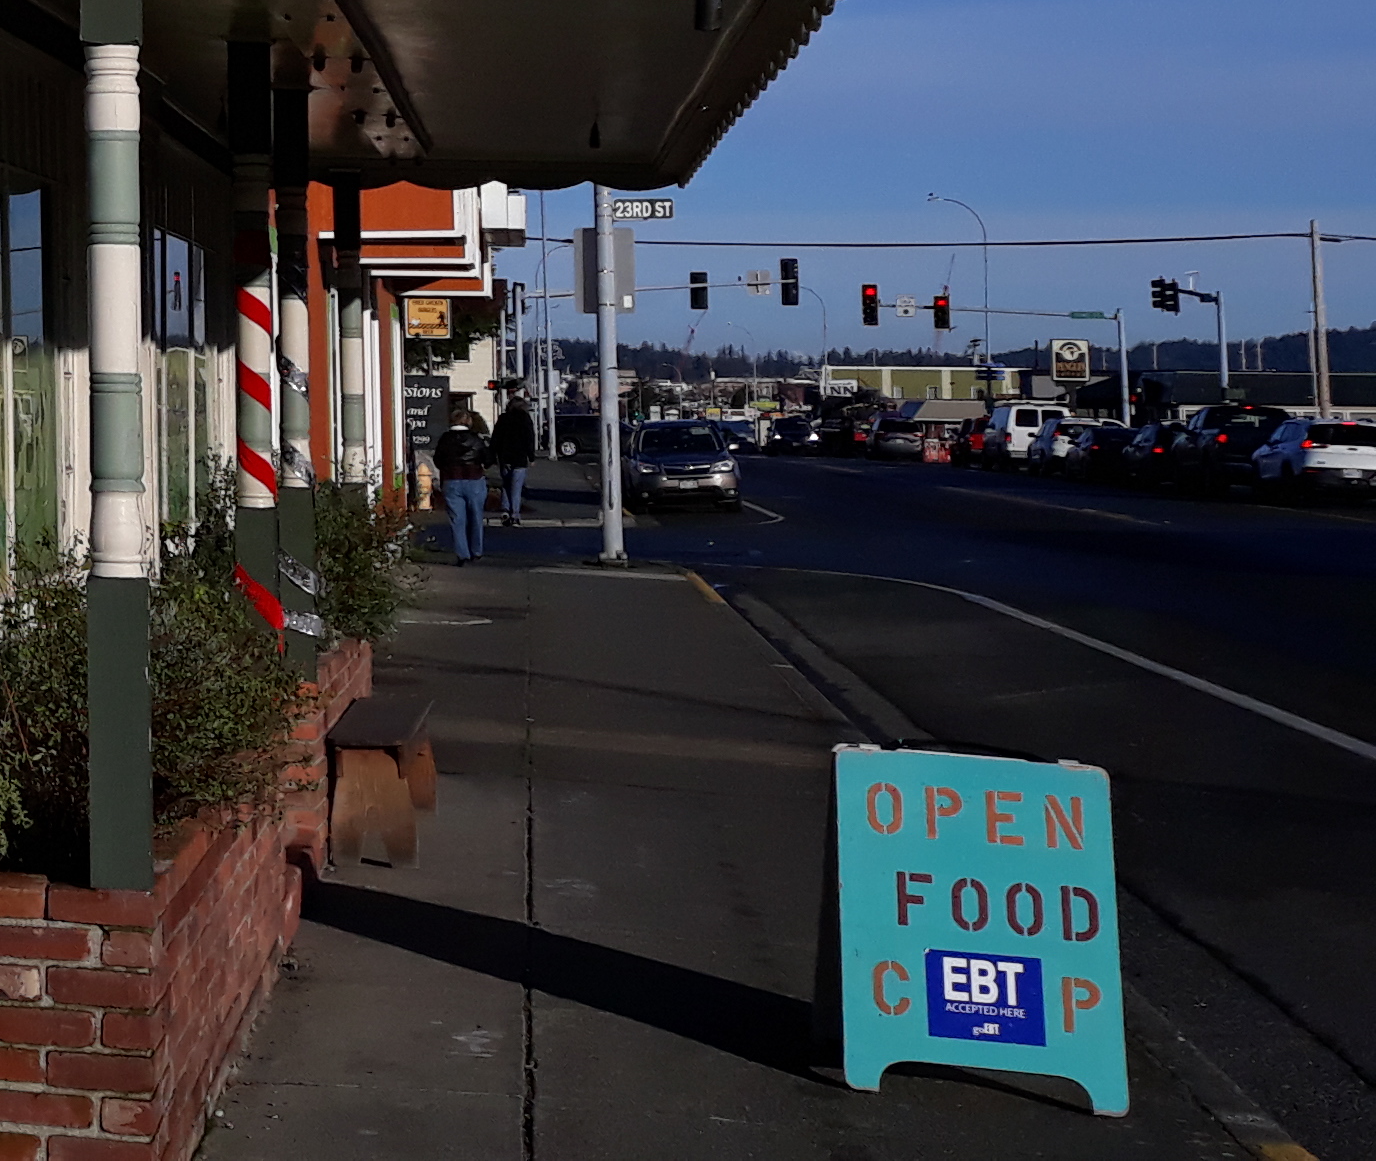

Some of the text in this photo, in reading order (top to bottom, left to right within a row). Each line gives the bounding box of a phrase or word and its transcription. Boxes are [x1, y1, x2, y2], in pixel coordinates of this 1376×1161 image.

[615, 201, 672, 217] 23RD ST
[866, 782, 1084, 851] OPEN
[896, 870, 1101, 942] FOOD
[942, 956, 1025, 1007] EBT
[945, 1002, 1027, 1019] ACCEPTED HERE
